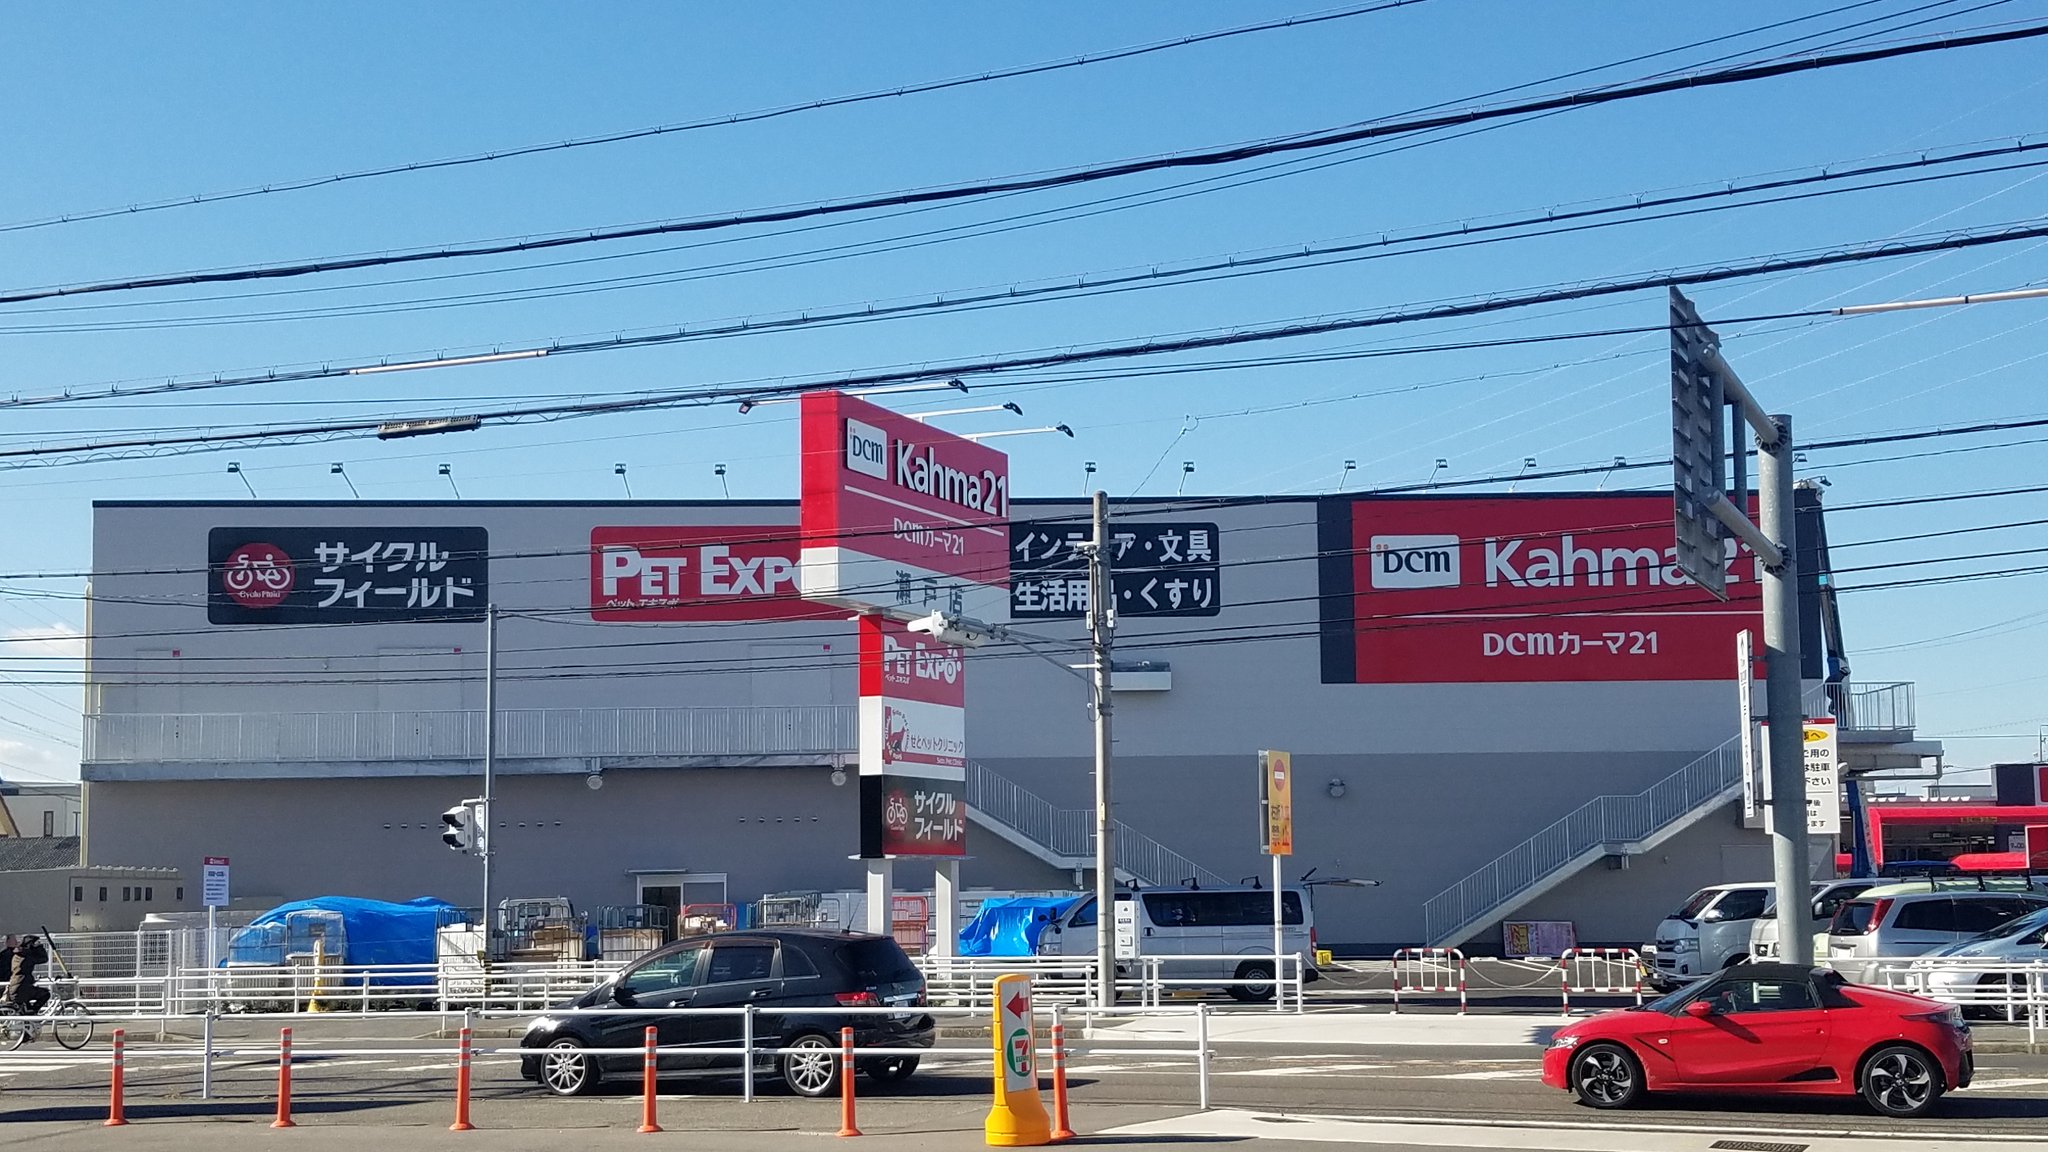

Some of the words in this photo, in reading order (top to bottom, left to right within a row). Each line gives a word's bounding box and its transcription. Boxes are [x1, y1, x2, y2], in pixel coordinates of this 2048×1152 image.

[896, 438, 1007, 518] Kahma21
[314, 541, 449, 573] サイクル
[1014, 528, 1212, 562] インテア・文具
[602, 545, 688, 596] PET
[700, 545, 802, 596] EXP
[314, 576, 475, 608] フィールド
[1014, 577, 1212, 611] 生活用・くすり
[883, 634, 913, 676] PET
[915, 641, 957, 685] EXPO
[914, 790, 956, 815] サイクル
[914, 817, 964, 841] フィールド
